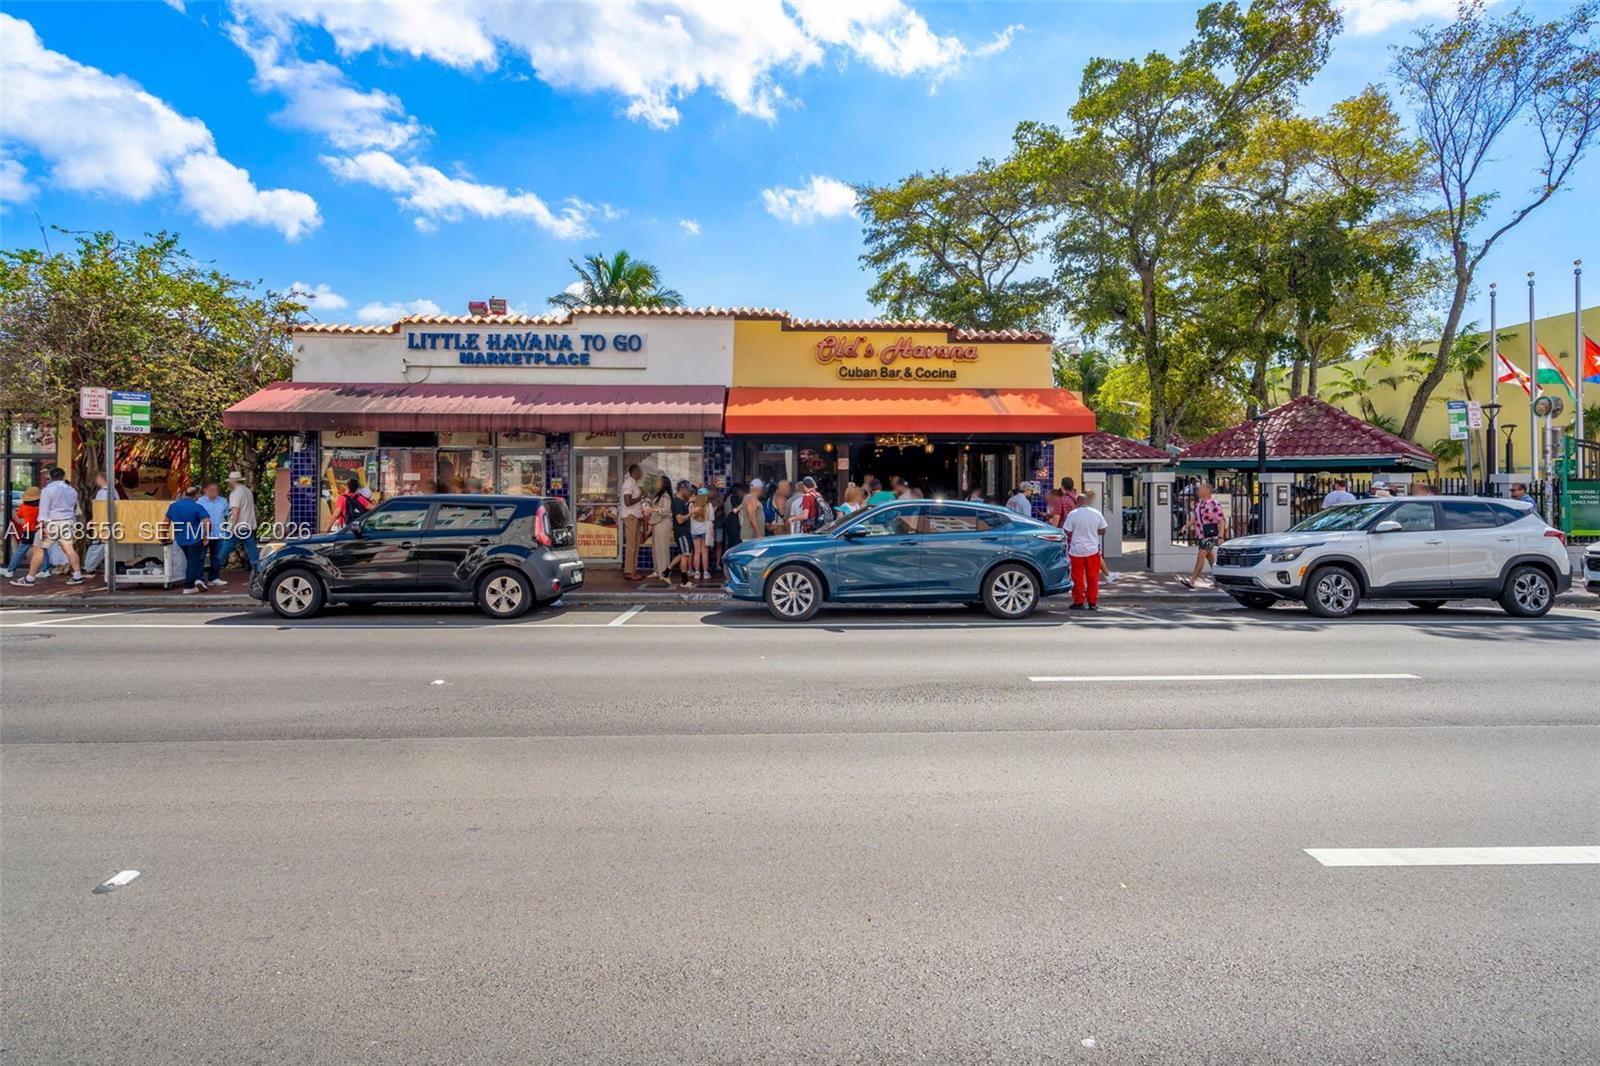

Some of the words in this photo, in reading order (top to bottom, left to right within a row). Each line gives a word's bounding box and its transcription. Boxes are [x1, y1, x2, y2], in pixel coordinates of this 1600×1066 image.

[407, 332, 480, 350] LITTLE
[487, 332, 573, 351] HAVANA
[580, 334, 606, 351] TO
[613, 334, 642, 351] GO
[817, 336, 875, 363] Old's
[879, 336, 978, 364] Havana
[459, 352, 590, 366] MARKETPLACE
[839, 366, 877, 378] Cuban
[880, 366, 900, 378] Bar
[904, 367, 912, 378] &
[915, 367, 957, 379] Cocina
